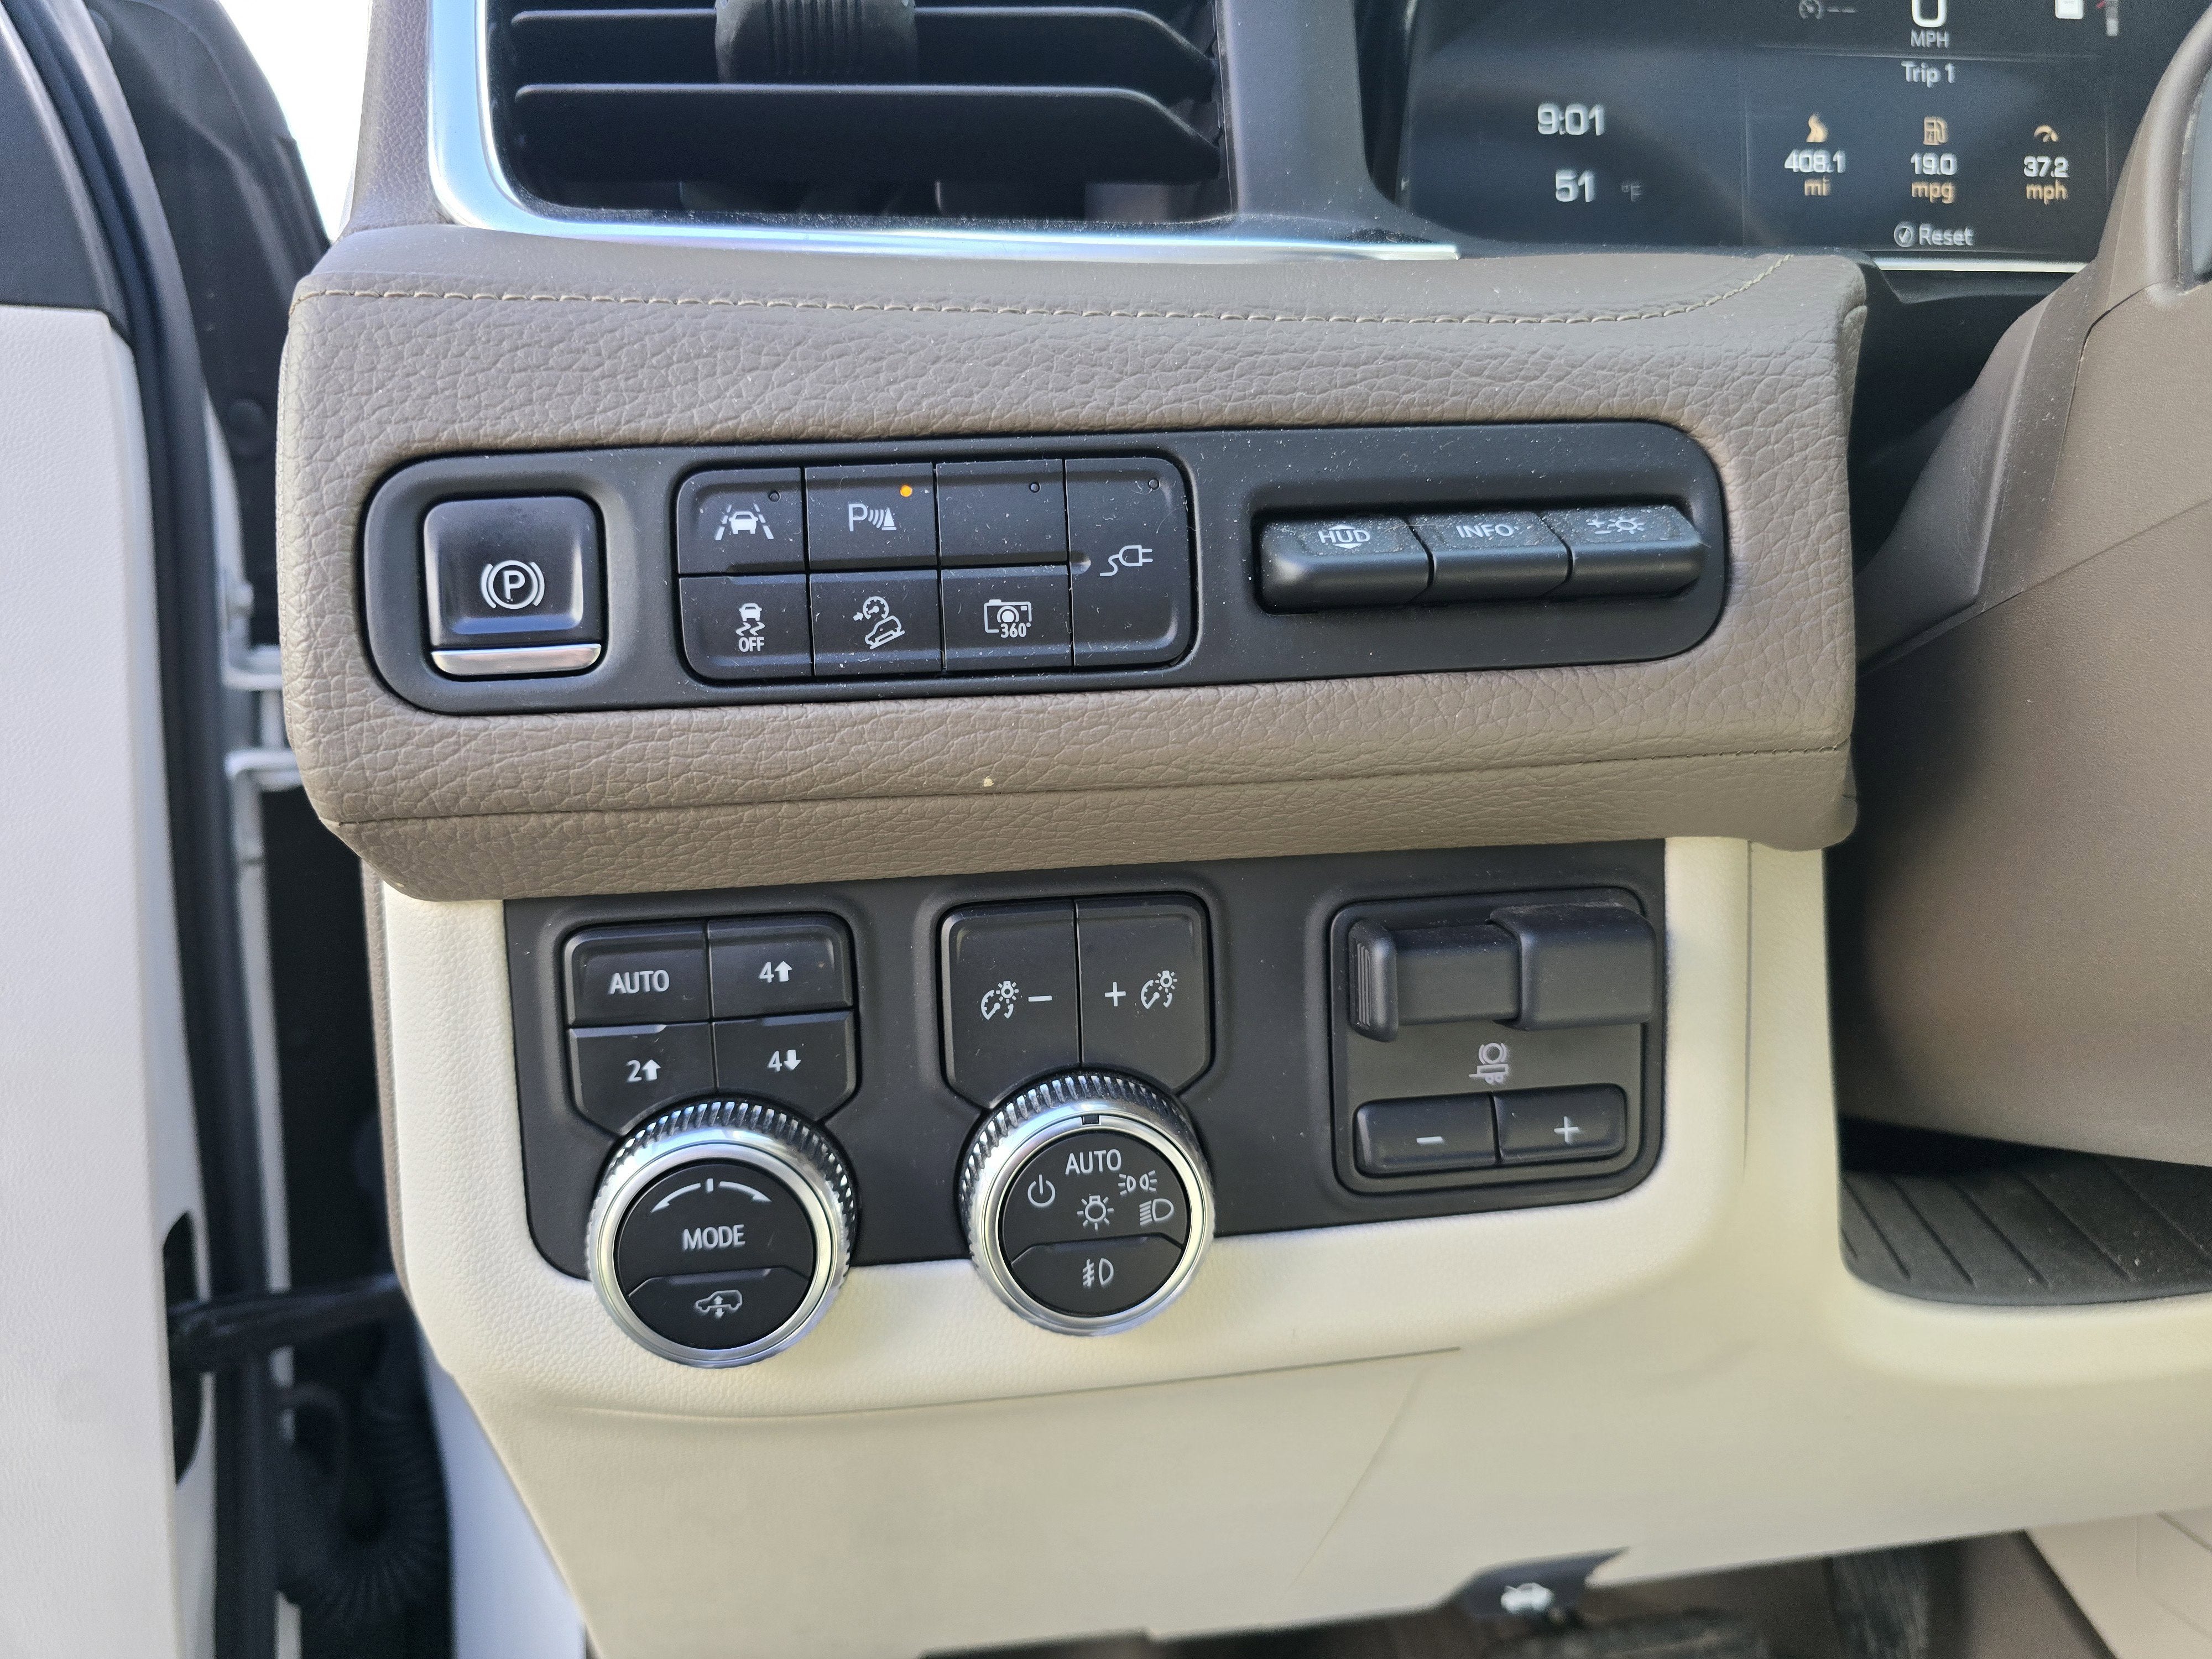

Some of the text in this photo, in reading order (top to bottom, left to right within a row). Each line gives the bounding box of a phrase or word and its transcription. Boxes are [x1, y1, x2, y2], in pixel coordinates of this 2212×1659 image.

[1911, 30, 1949, 48] MPH
[1901, 61, 1955, 87] Trip 1
[1537, 103, 1604, 135] 9:01
[1785, 149, 1846, 173] 408.1
[1911, 153, 1958, 175] 19.0
[2023, 156, 2069, 178] 37.2
[1555, 169, 1595, 202] 51
[1804, 177, 1831, 196] mi
[1912, 181, 1954, 203] mpg
[2026, 181, 2068, 204] mph
[1919, 224, 1974, 246] Reset
[848, 504, 868, 531] P
[1318, 529, 1370, 544] HUD
[1456, 523, 1514, 539] INFO
[503, 570, 525, 600] P
[738, 637, 764, 653] OFF
[609, 969, 669, 994] AUTO
[759, 962, 774, 983] 4
[627, 1060, 642, 1082] 2
[768, 1051, 782, 1071] 4
[1065, 1149, 1122, 1176] AUTO
[682, 1224, 745, 1251] MODE
